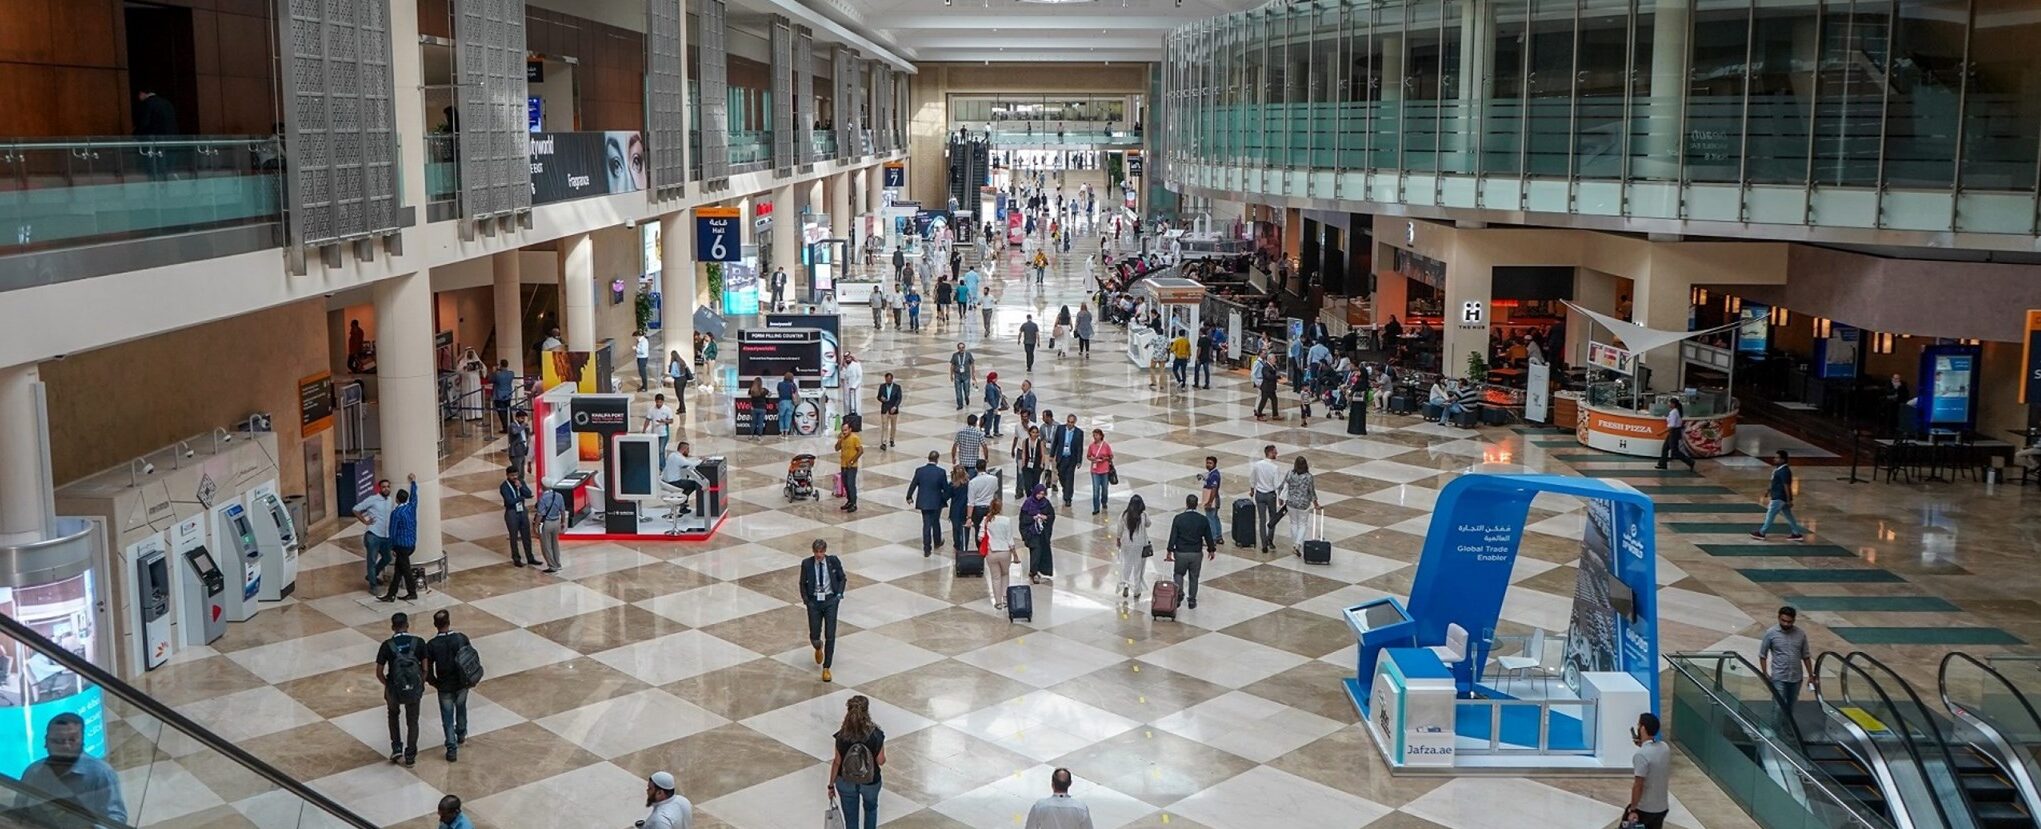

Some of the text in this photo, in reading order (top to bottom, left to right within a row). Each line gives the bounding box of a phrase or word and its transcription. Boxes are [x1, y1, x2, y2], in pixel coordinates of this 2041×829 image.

[567, 173, 590, 190] Fragrance
[891, 174, 898, 186] 7
[711, 235, 727, 259] 6
[1598, 419, 1653, 433] FRESH PIZZA
[1457, 545, 1508, 553] Global Trade
[1407, 745, 1453, 755] Jafza.ae
